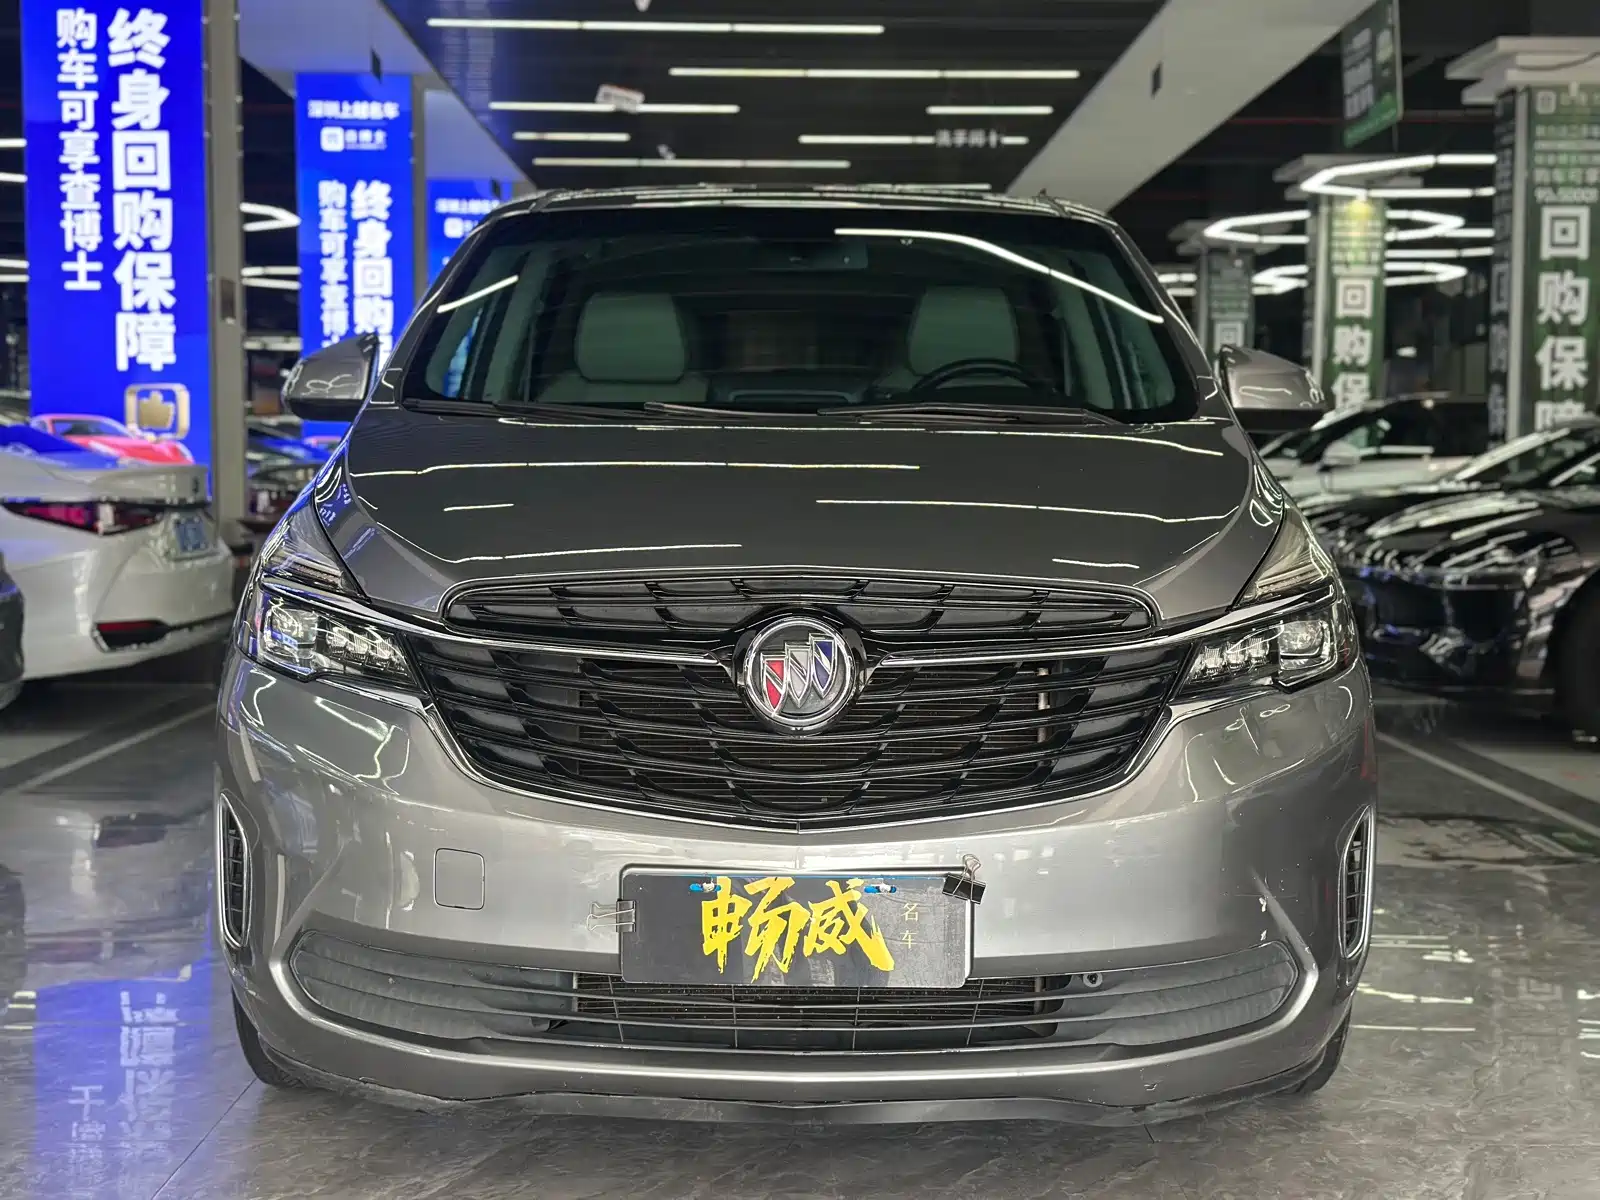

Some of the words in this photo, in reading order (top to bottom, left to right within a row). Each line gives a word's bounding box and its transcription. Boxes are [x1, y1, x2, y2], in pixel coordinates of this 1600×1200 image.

[56, 8, 102, 291] 购车可享查博士
[107, 9, 177, 372] 终身回购保障
[702, 876, 894, 983] 畅威
[899, 902, 918, 950] 名车
